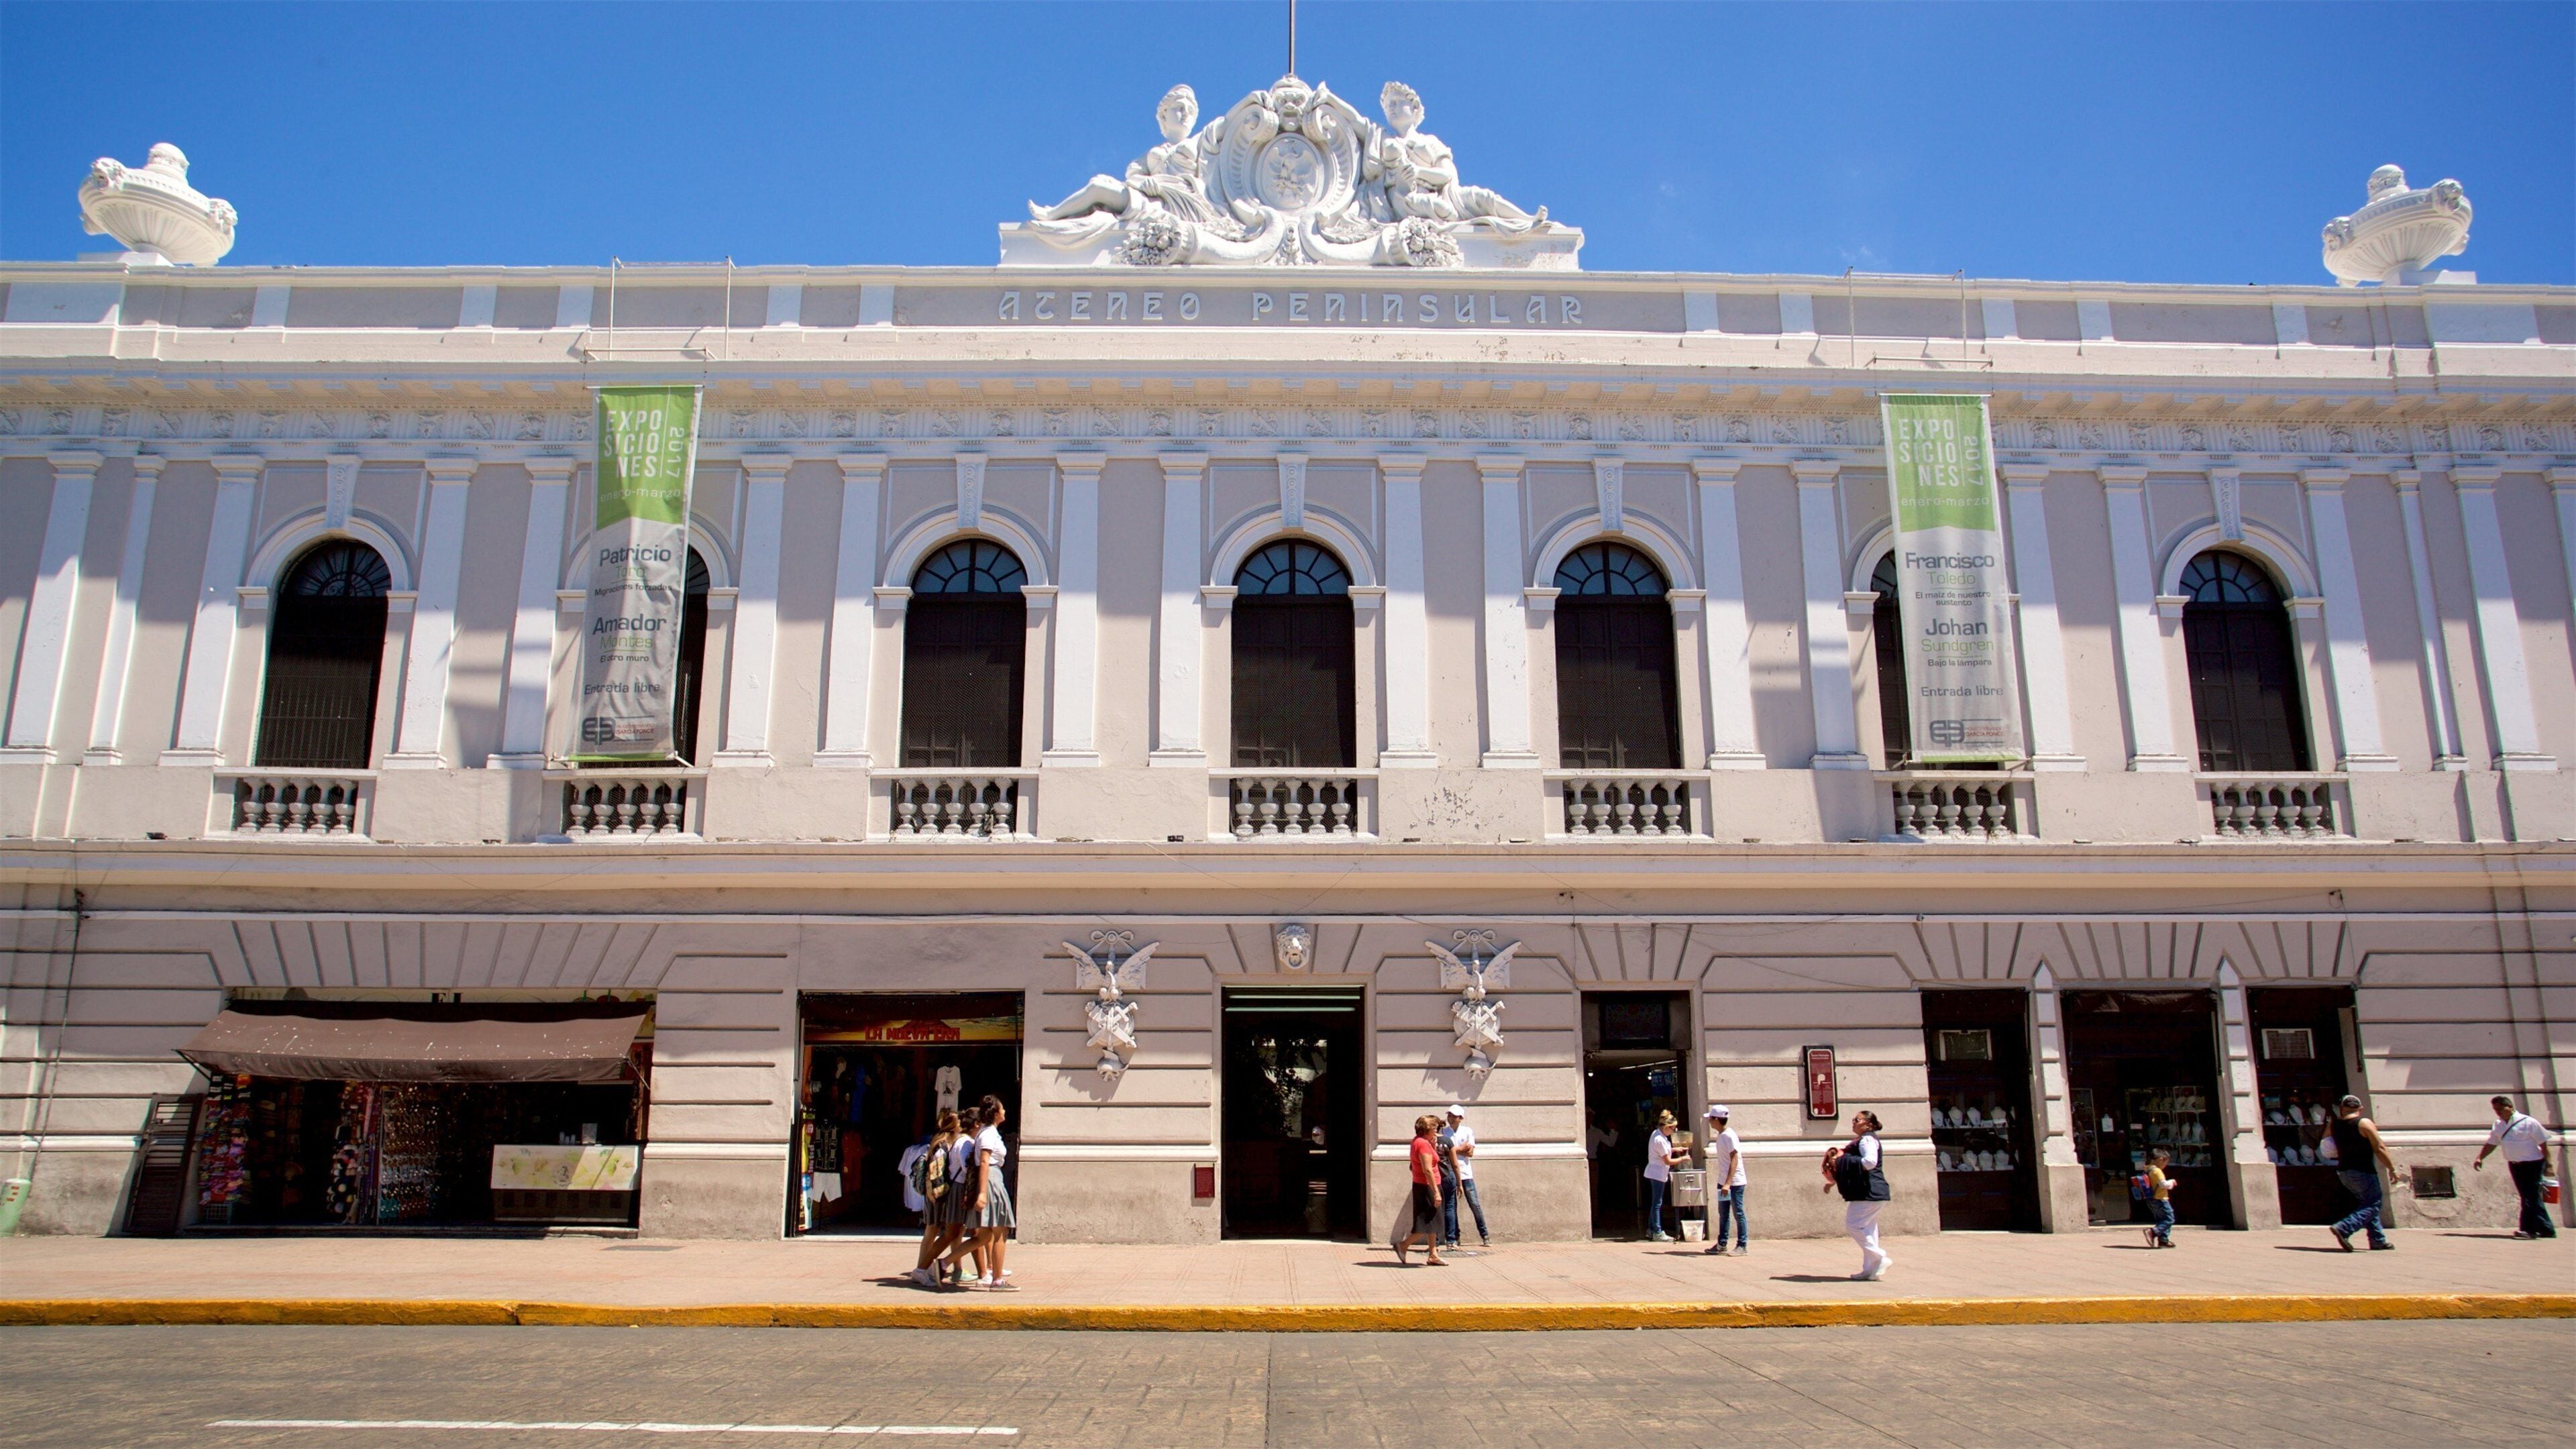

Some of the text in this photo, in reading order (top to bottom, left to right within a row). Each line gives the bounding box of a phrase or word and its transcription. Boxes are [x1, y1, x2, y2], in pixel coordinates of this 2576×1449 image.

[998, 290, 1582, 324] ATENEO PENINSULAR
[606, 409, 662, 432] EXPO
[1898, 418, 1955, 441] EXPO
[604, 432, 659, 457] SICIO
[666, 427, 685, 478] 2017
[1898, 441, 1957, 464] SICIO
[616, 455, 657, 478] NES
[1964, 435, 1984, 486] 2017
[1918, 464, 1960, 488] NES
[1901, 497, 1990, 506] enero-marzo
[600, 543, 672, 567] Patricio
[1905, 552, 1995, 570] Francisco
[1926, 571, 1976, 585] Toledo
[592, 613, 667, 635] Amador
[1925, 618, 1988, 636] Johan
[600, 635, 653, 649] Montes
[1921, 639, 1994, 655] Sundgren
[1927, 659, 1947, 668] Bajo
[584, 682, 661, 695] Entrada libre
[1921, 685, 2004, 697] Entrada libre
